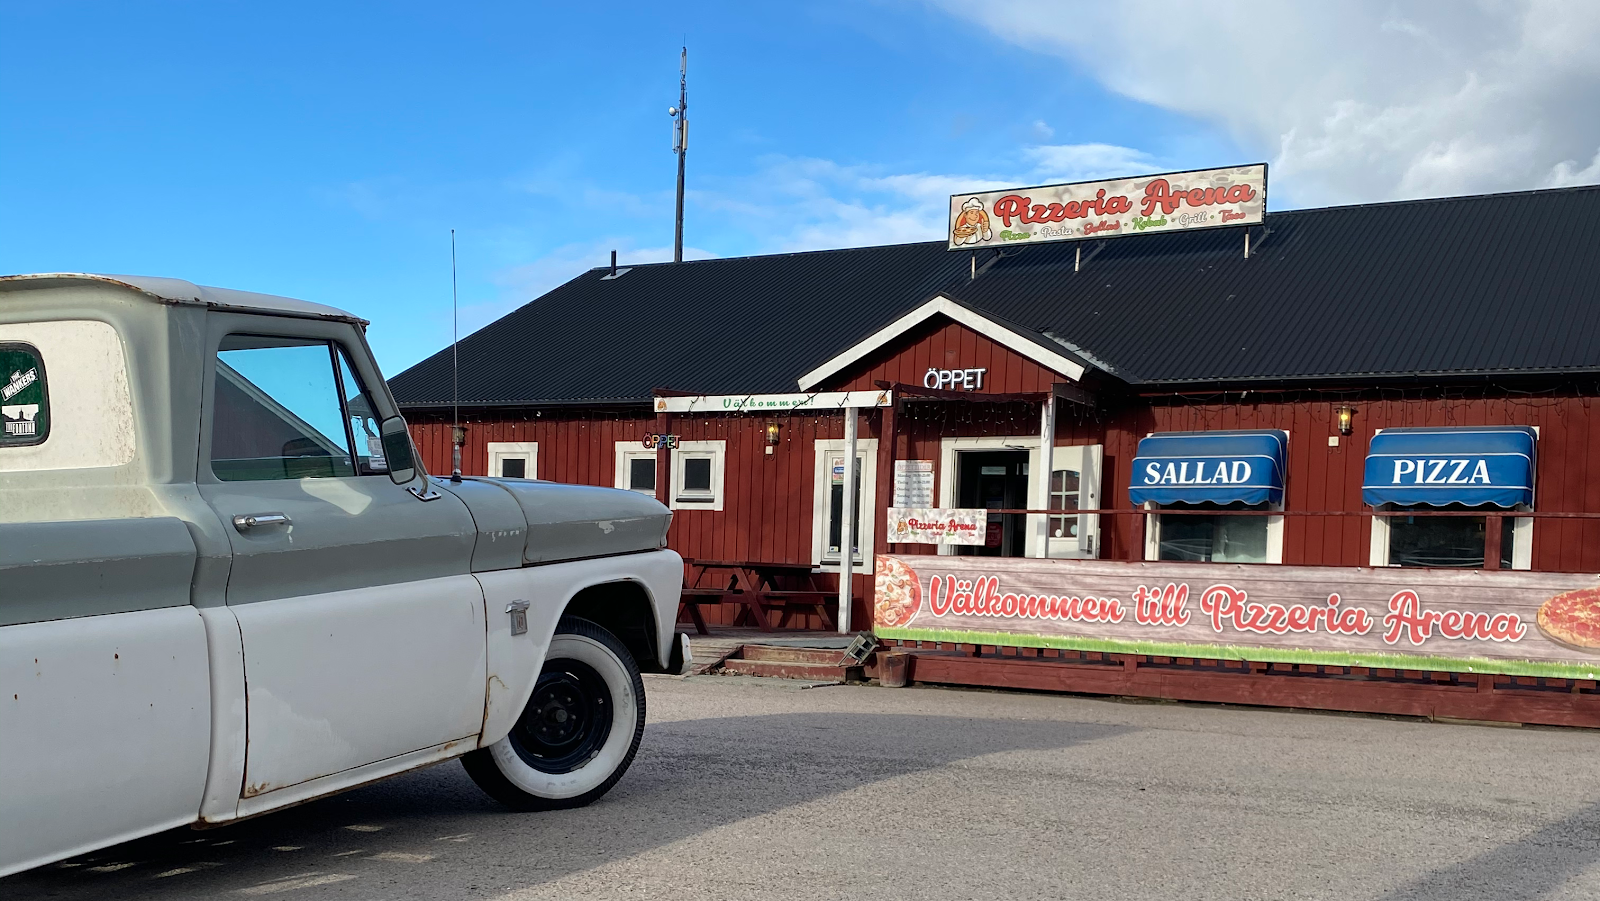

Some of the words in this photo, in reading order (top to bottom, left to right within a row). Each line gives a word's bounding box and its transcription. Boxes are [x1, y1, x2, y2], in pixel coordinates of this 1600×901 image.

[993, 188, 1133, 227] Pizzeria
[1141, 178, 1256, 217] Arena
[1041, 226, 1074, 238] Pasta
[1179, 211, 1208, 228] Grill
[3, 370, 36, 398] WANKERS
[923, 367, 986, 390] ÖPPET
[642, 432, 681, 449] ÖPPET
[1143, 460, 1252, 485] SALLAD
[1391, 459, 1491, 484] PIZZA
[908, 518, 946, 530] Pizzeria
[948, 519, 977, 532] Arena
[929, 574, 1126, 624] Välkommen
[1132, 582, 1191, 627] till
[1200, 583, 1374, 636] Pizzeria
[1383, 589, 1527, 645] Arena
